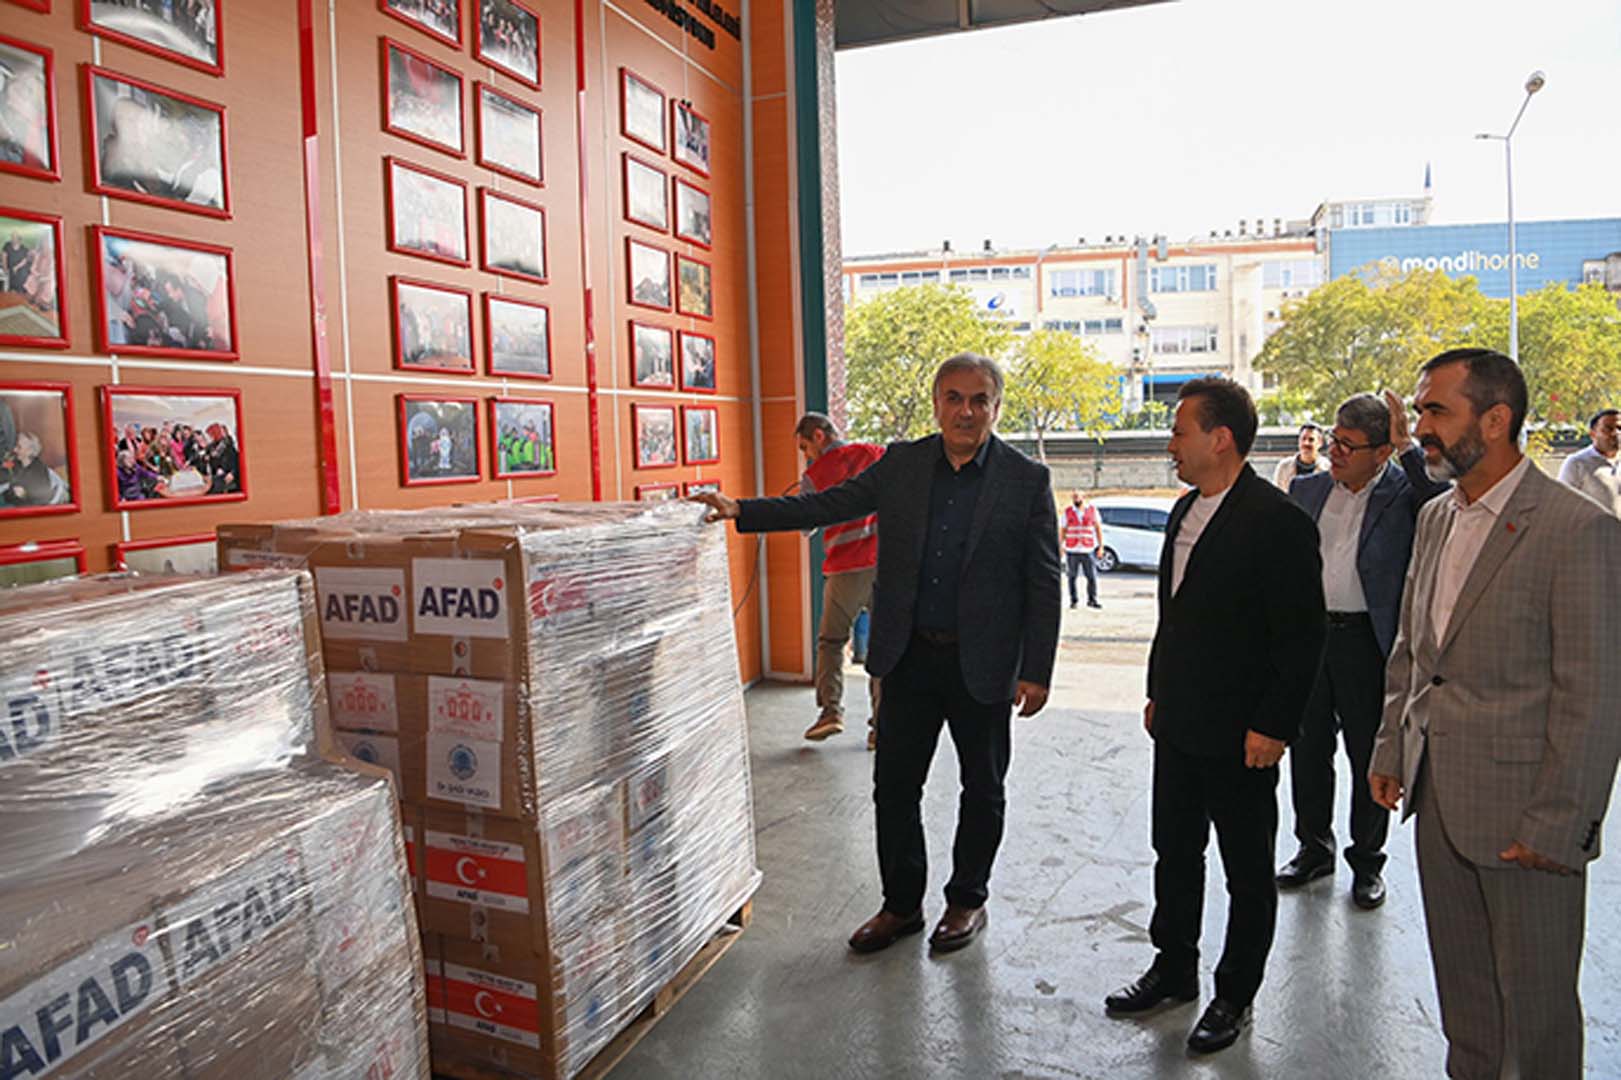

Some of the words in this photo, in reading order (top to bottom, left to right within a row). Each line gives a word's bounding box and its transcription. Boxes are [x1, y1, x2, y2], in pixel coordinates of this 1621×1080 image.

[1402, 251, 1540, 273] mondihome
[325, 594, 398, 624] AFAD
[418, 587, 499, 619] AFAD
[181, 871, 298, 978] AFAD
[0, 952, 152, 1080] AFAD
